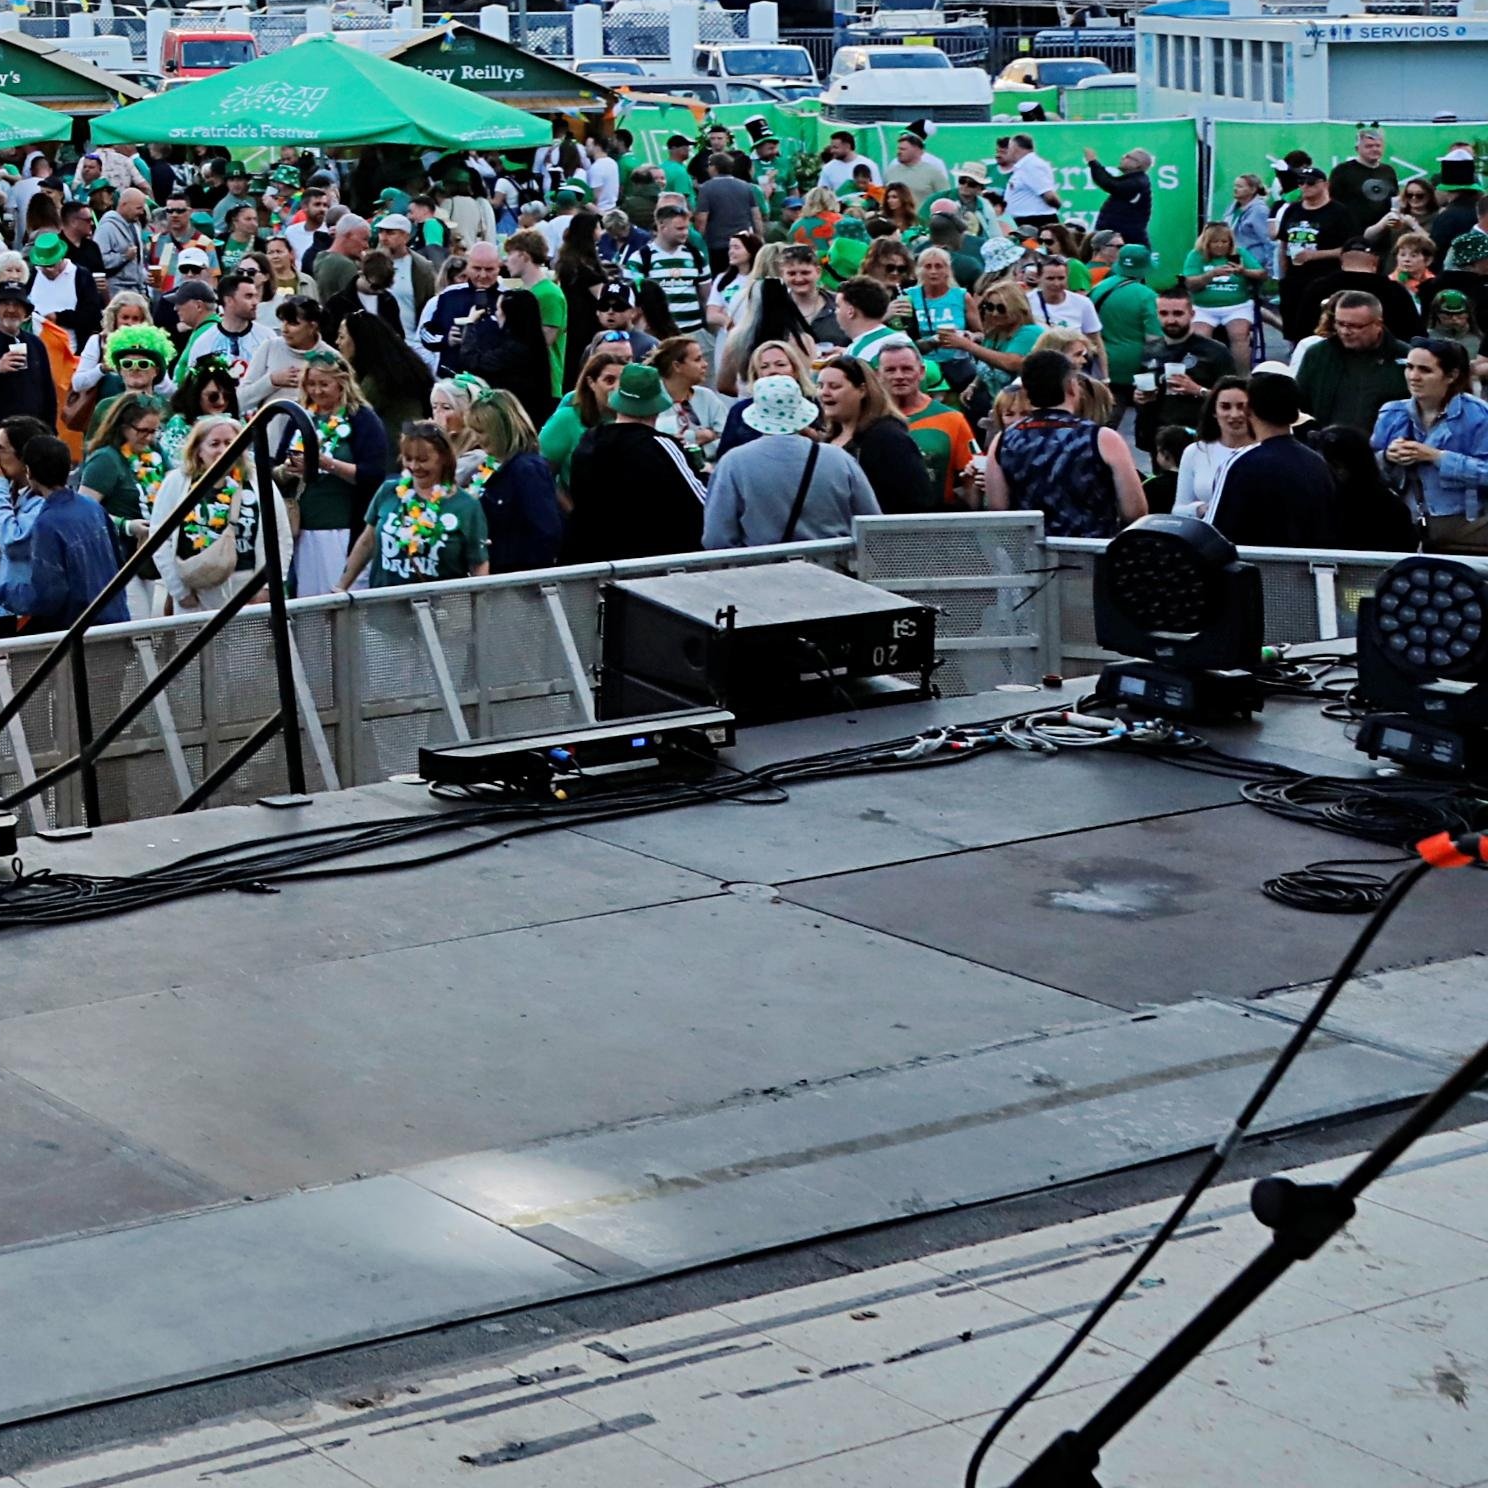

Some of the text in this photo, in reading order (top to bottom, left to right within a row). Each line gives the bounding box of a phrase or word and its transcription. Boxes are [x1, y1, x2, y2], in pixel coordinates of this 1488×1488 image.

[1360, 26, 1449, 39] SERVICIOS
[411, 65, 524, 83] icey Reillys
[191, 124, 258, 139] Patrick's
[381, 555, 439, 579] DRINK
